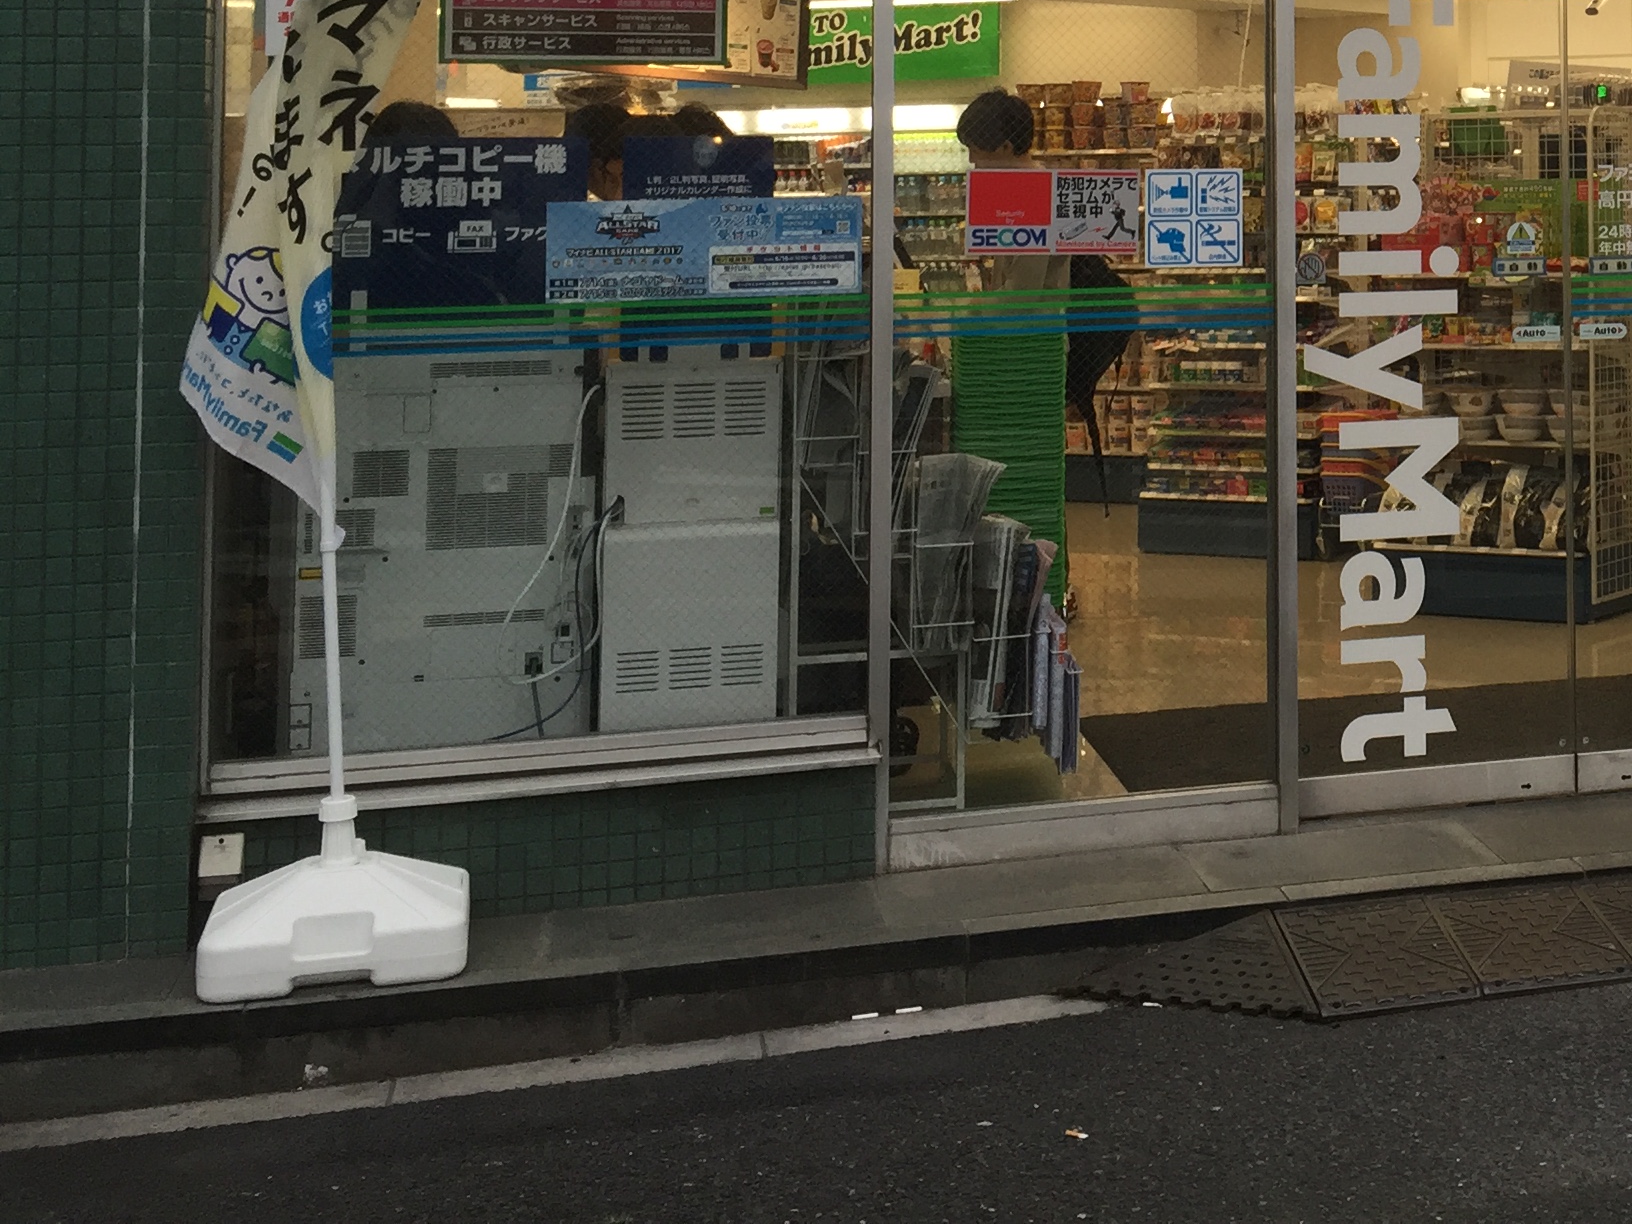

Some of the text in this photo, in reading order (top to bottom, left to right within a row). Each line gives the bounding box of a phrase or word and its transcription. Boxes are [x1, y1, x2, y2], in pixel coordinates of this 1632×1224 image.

[482, 13, 598, 28] スキャンサービス
[813, 12, 846, 34] TO
[481, 35, 572, 50] 行政サービス
[1056, 176, 1139, 191] 防犯カメラで
[400, 176, 503, 208] 稼働中
[1056, 190, 1116, 205] セコムが
[1055, 204, 1104, 219] 監視中
[382, 227, 432, 243] コピー
[466, 225, 485, 233] FAX
[971, 228, 1047, 247] SECOM
[1522, 328, 1546, 338] Auto
[1594, 326, 1617, 336] Auto
